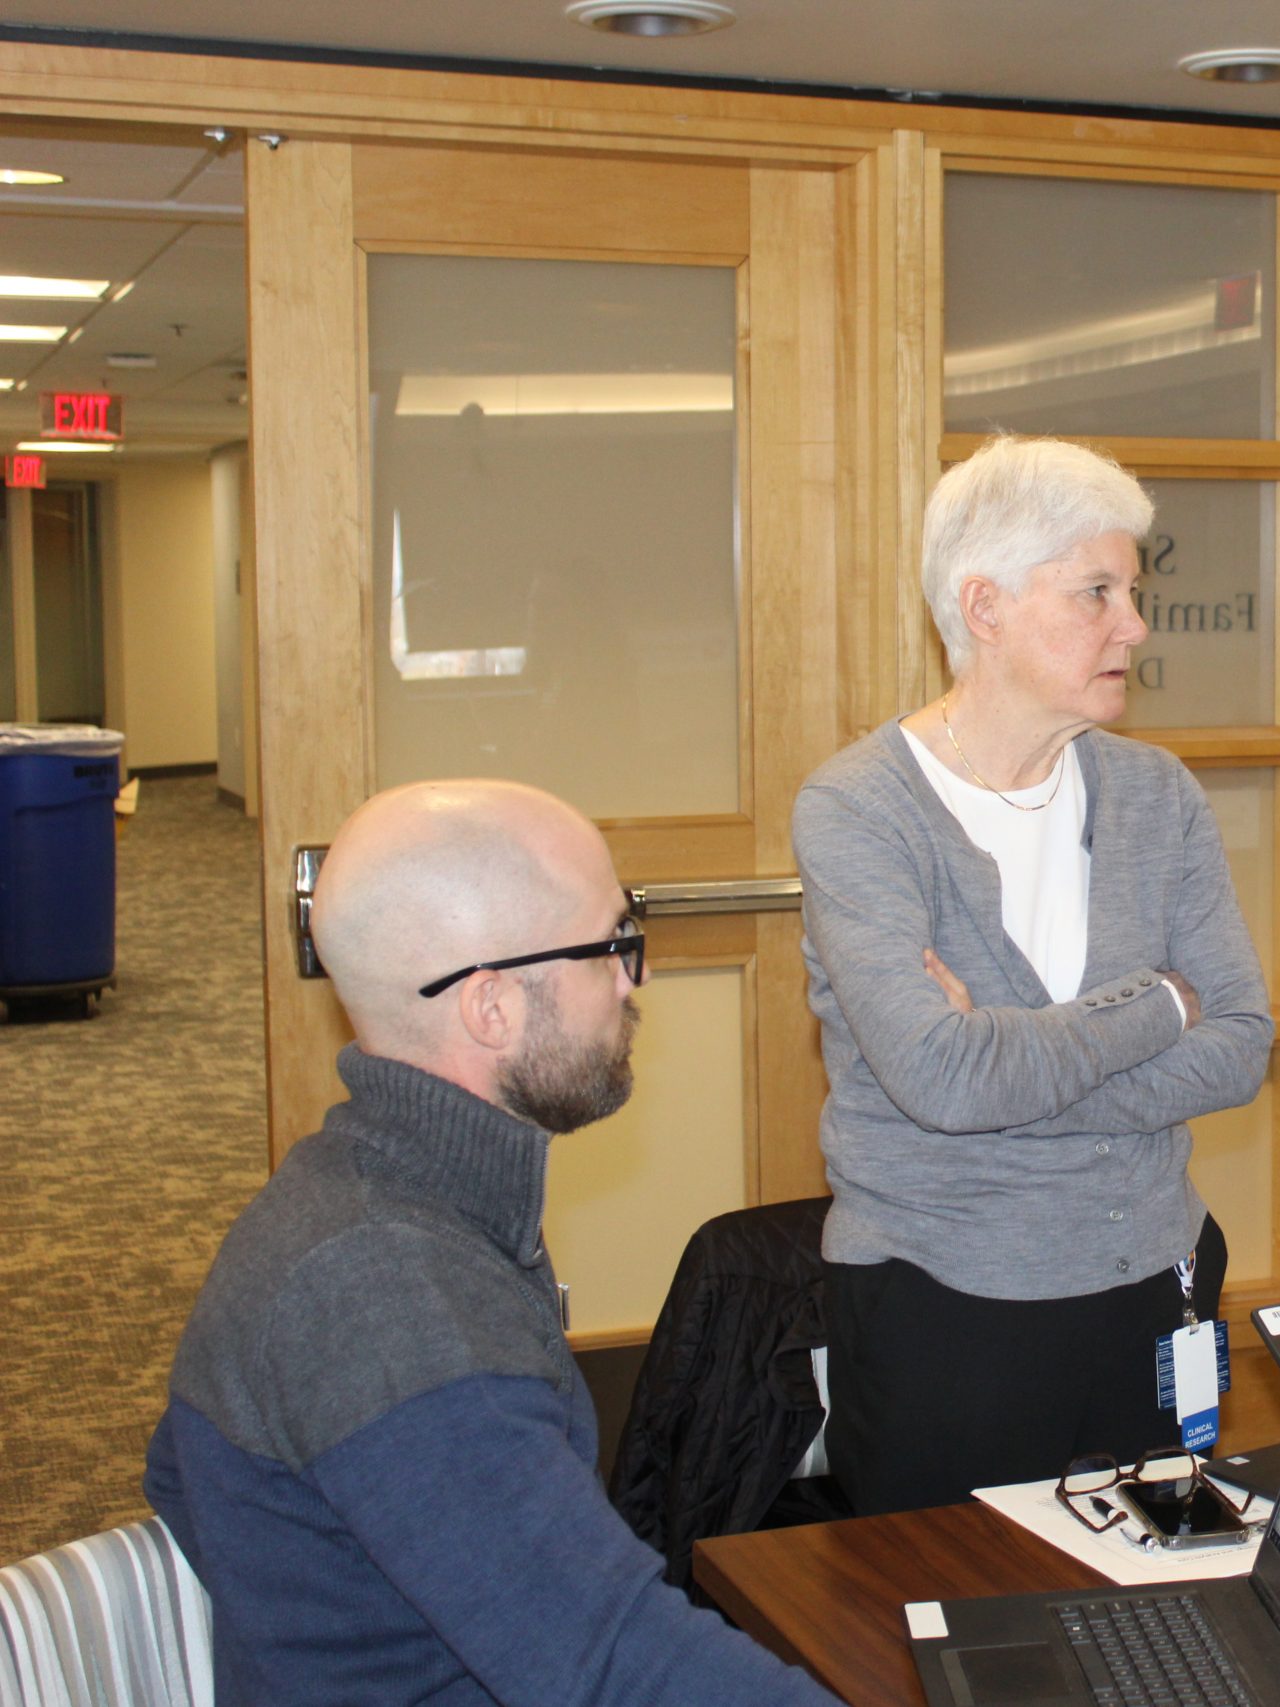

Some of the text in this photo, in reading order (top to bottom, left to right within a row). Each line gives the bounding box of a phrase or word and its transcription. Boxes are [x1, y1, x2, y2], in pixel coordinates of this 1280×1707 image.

[54, 394, 111, 432] EXIT
[13, 456, 42, 485] EXIT
[1184, 1431, 1216, 1449] RESEARCH
[1187, 1421, 1213, 1438] CLINICAL
